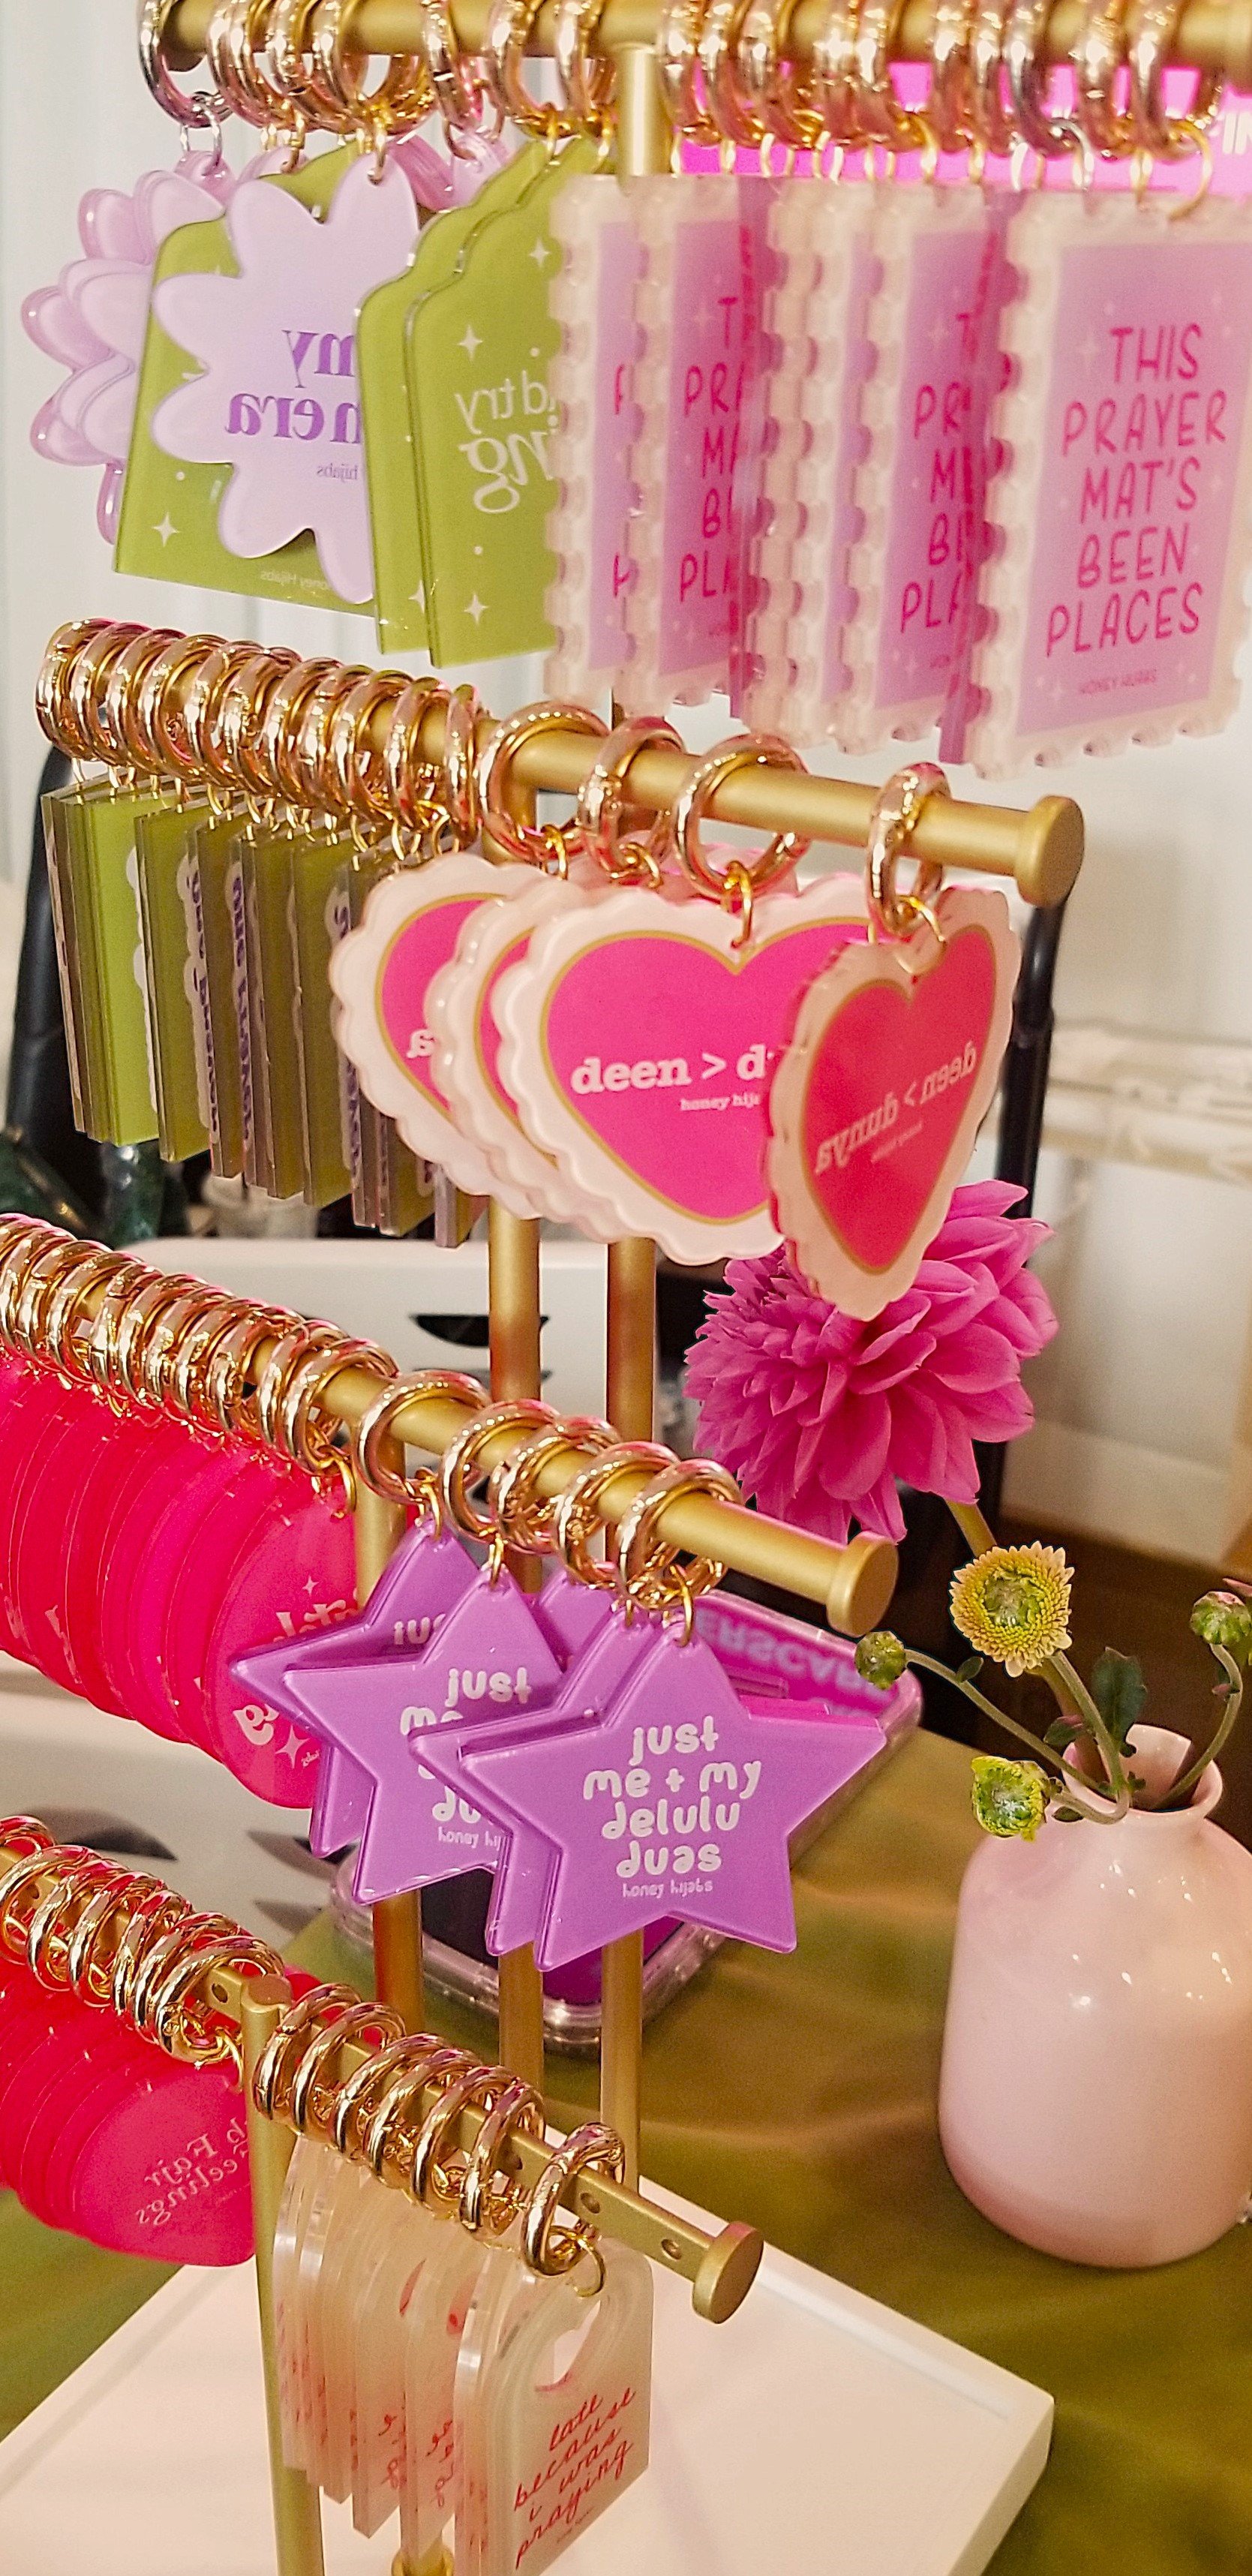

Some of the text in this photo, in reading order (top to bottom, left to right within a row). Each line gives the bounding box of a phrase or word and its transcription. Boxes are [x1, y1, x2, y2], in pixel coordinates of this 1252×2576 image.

[1109, 323, 1204, 383] THIS
[1061, 388, 1227, 457] PRAYER
[1079, 455, 1201, 524] MAT'S
[1076, 523, 1190, 590] BEEN
[1046, 581, 1203, 658] PLACES
[570, 1055, 692, 1095] deen
[445, 1667, 531, 1708] just
[629, 1716, 719, 1766] just
[583, 1760, 761, 1799] me + my
[438, 1827, 479, 1848] honey
[602, 1796, 740, 1840] delulu
[616, 1840, 722, 1878] duas
[622, 1878, 713, 1899] honey hijabs
[514, 2387, 637, 2512] because
[549, 2394, 603, 2452] late
[559, 2427, 622, 2495] was
[515, 2440, 635, 2570] praying
